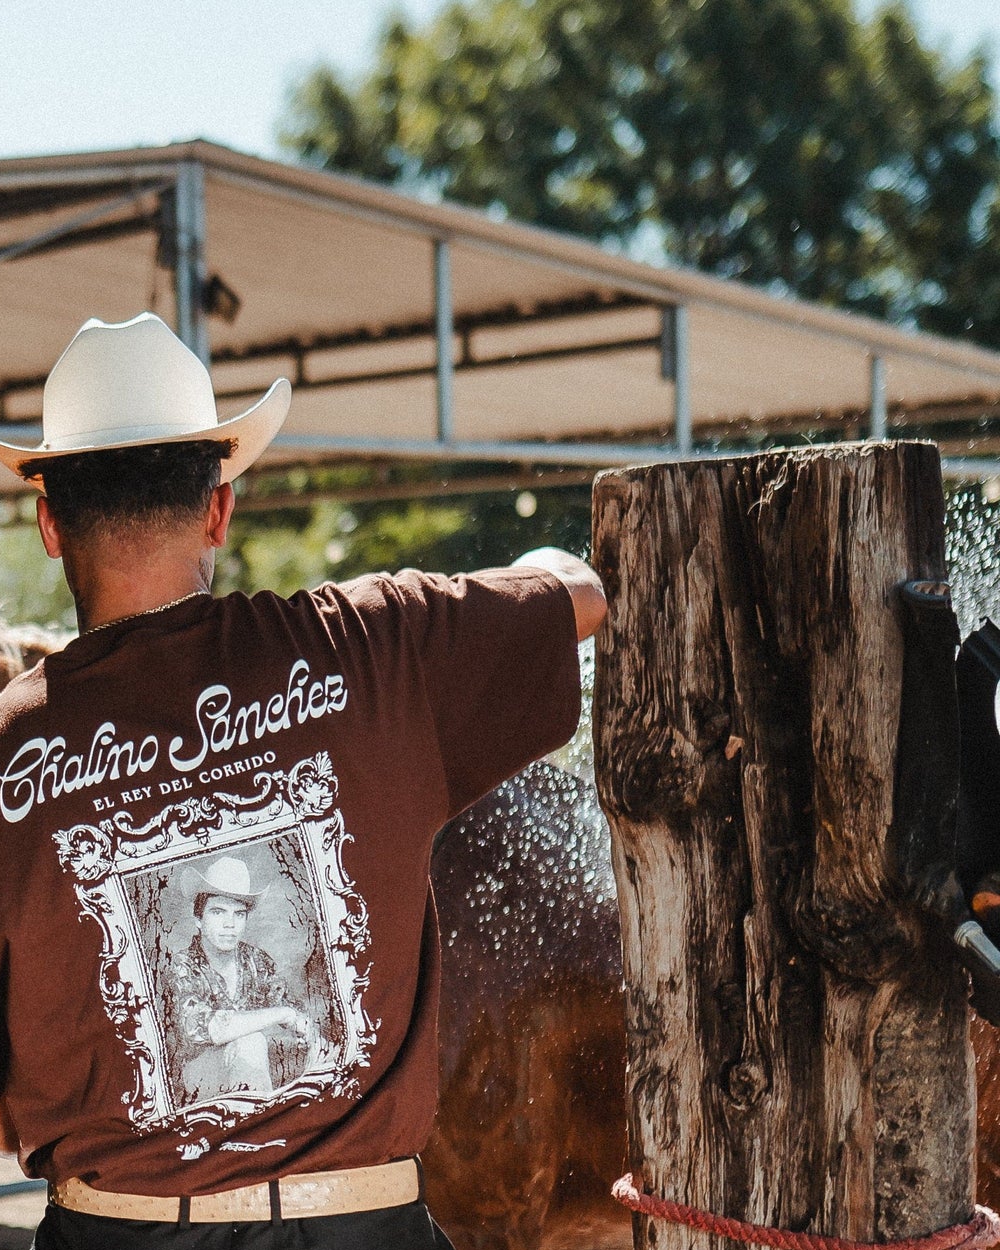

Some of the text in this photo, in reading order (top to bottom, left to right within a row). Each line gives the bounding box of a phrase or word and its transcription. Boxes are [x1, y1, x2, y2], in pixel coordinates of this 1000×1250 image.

[169, 658, 348, 772] Sanchez
[93, 750, 277, 812] EL REY DEL CORRIDO
